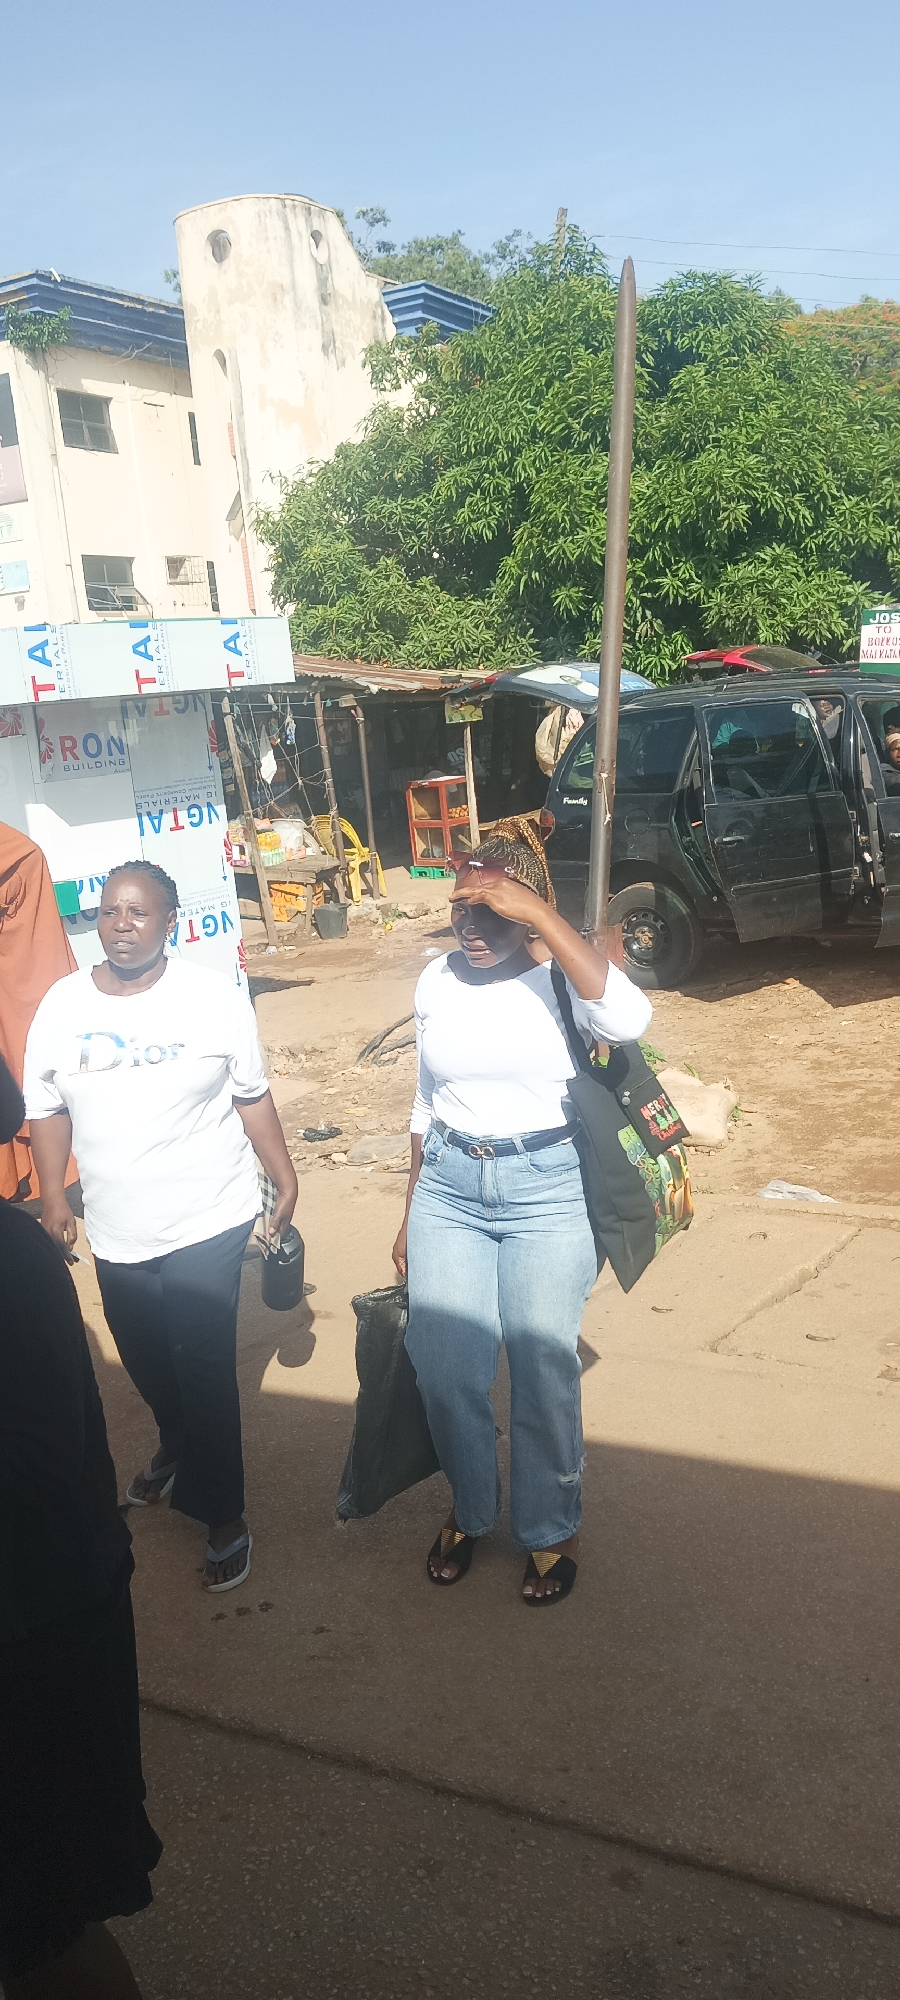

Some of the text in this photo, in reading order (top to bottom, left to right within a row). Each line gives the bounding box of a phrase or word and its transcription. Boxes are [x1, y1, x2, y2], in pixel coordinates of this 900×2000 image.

[870, 613, 900, 623] JOS
[59, 732, 126, 762] RON
[63, 758, 126, 772] BUILDING
[562, 796, 588, 806] Family
[68, 1031, 186, 1077] Dior
